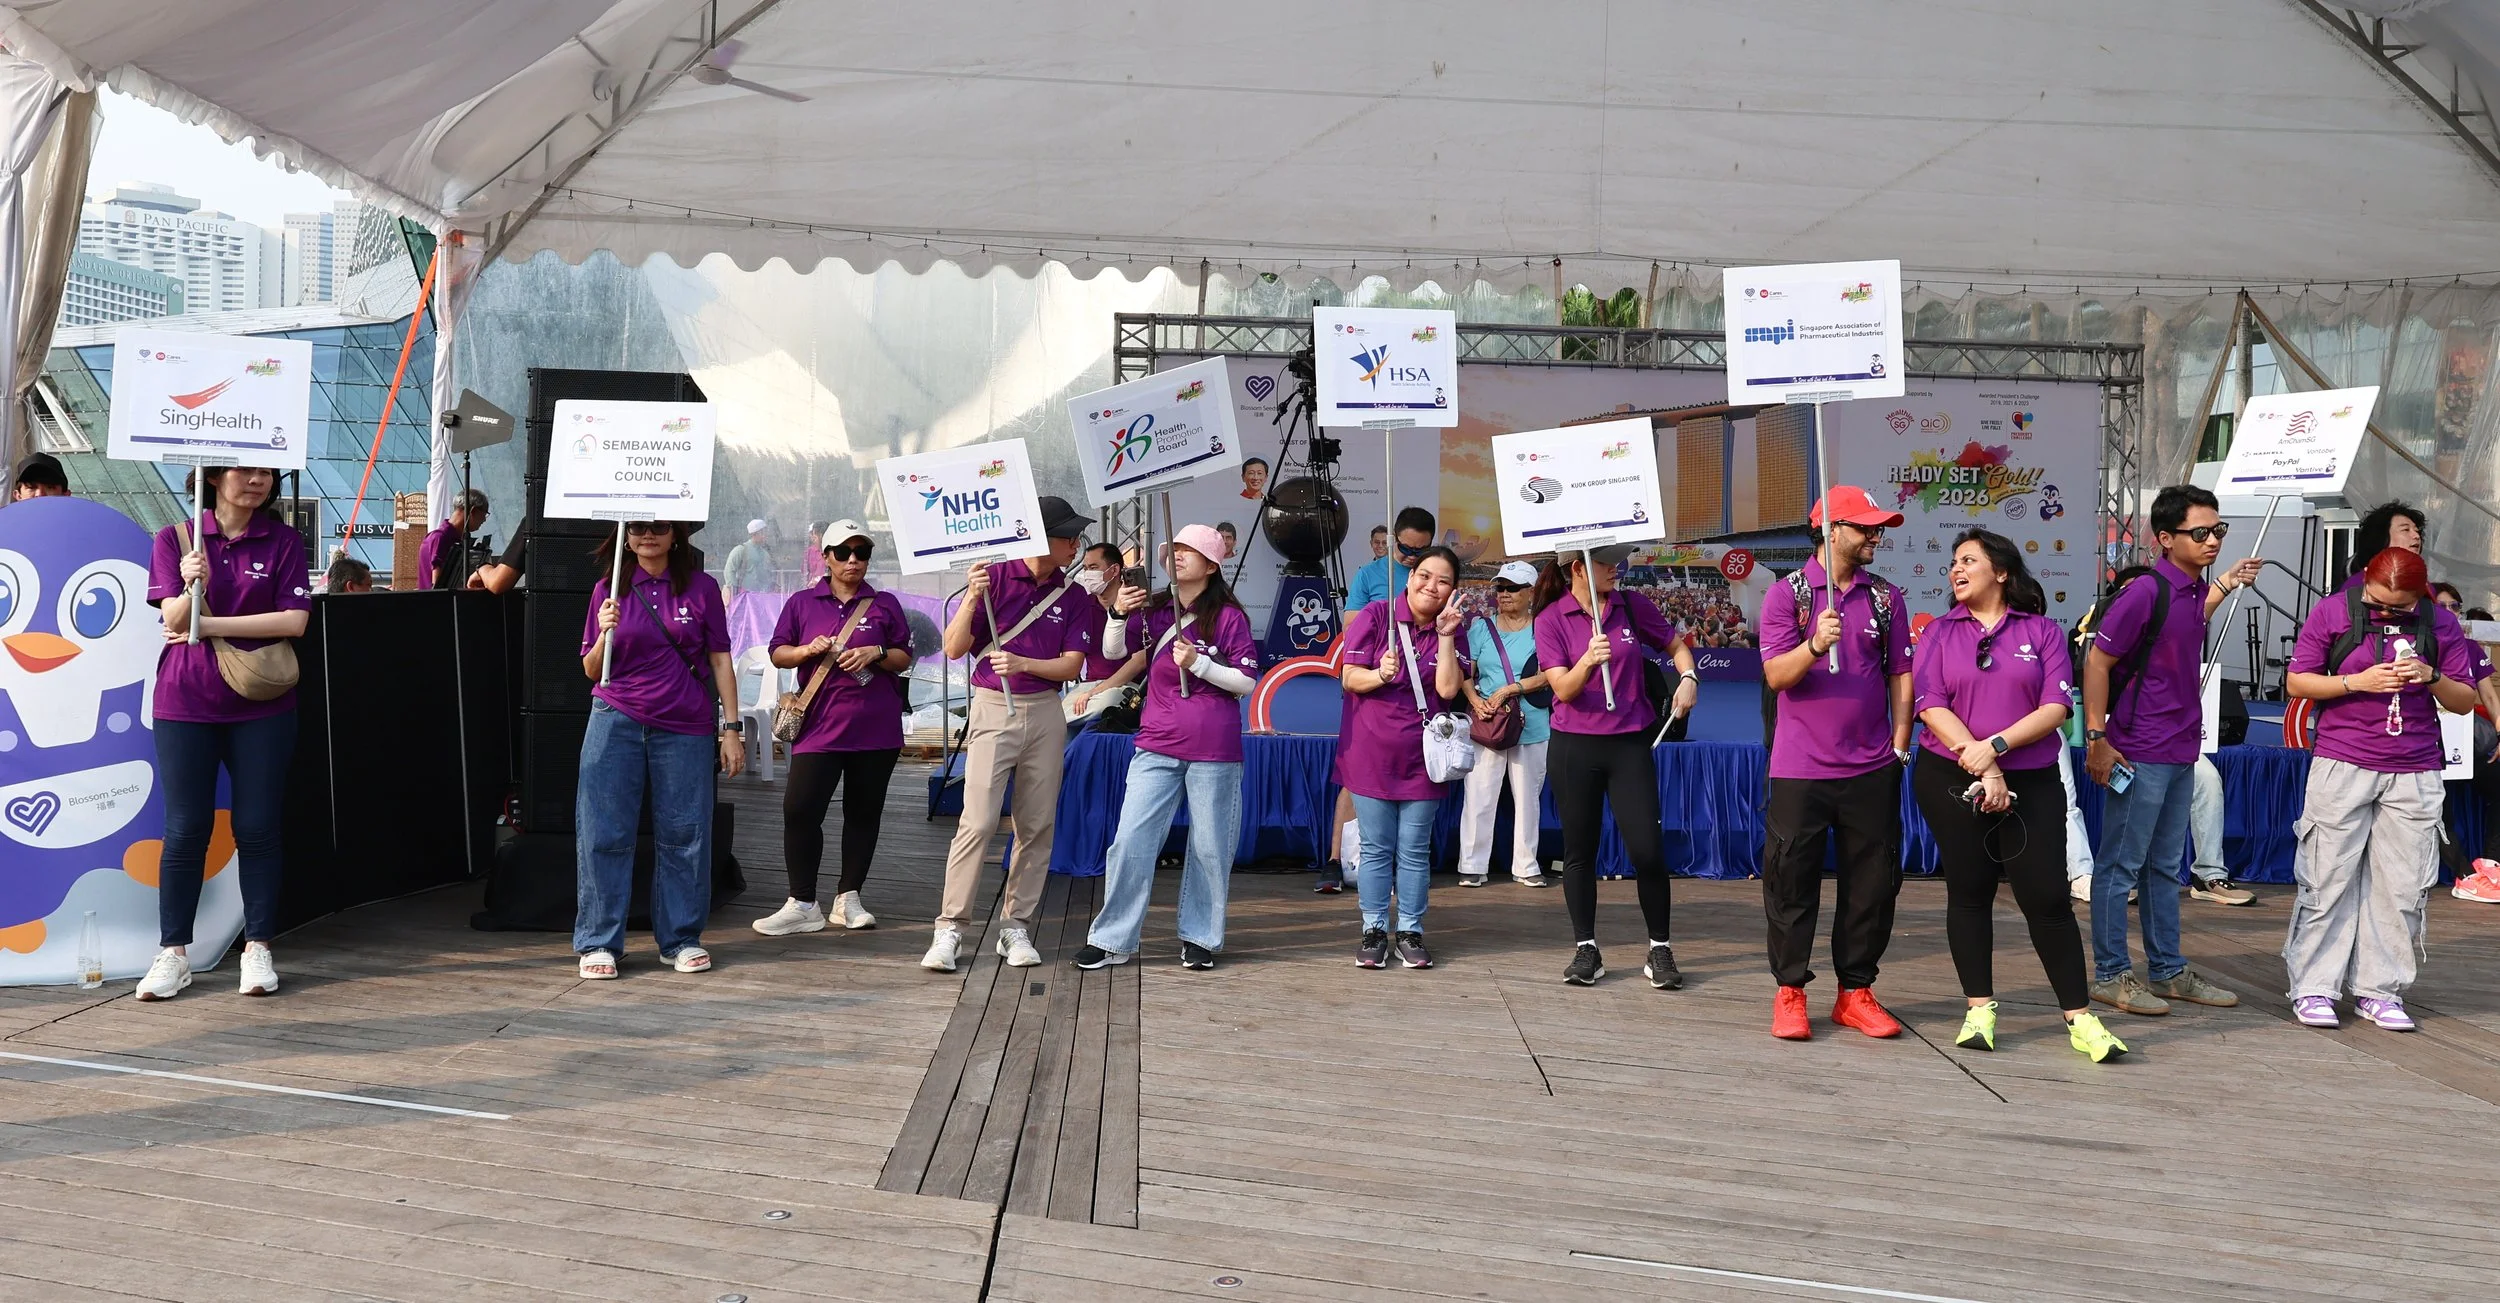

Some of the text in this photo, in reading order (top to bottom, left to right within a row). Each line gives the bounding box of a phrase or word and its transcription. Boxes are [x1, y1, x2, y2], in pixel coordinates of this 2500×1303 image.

[143, 213, 228, 234] PAN PACIFIC
[118, 269, 164, 288] ORIENTAL
[1800, 324, 1833, 333] Singapore
[1835, 322, 1872, 330] Association
[1800, 329, 1884, 340] Pharmaceutical Industries
[1389, 367, 1431, 382] HSA
[160, 409, 262, 430] SingHealth
[472, 415, 500, 425] SHURE
[1885, 409, 1915, 424] Healthier
[1155, 422, 1187, 438] Health
[1894, 421, 1906, 429] SG
[1156, 426, 1203, 446] Promotion
[2277, 435, 2317, 445] AmChamSG
[602, 440, 692, 451] SEMBAWANG
[1158, 439, 1188, 453] Board
[626, 456, 666, 466] TOWN
[2272, 458, 2300, 467] PayPal
[614, 471, 675, 482] COUNCIL
[1571, 475, 1641, 489] KUOK GROUP SINGAPORE
[1887, 463, 2045, 490] READY SET Gold!
[942, 488, 1000, 517] NHG
[1938, 488, 1990, 506] 2026
[945, 512, 1002, 535] Health
[1661, 548, 1676, 557] SET
[1728, 553, 1747, 564] SG
[1726, 565, 1745, 575] 60
[1697, 653, 1731, 670] Care
[69, 784, 140, 807] Blossom Seeds
